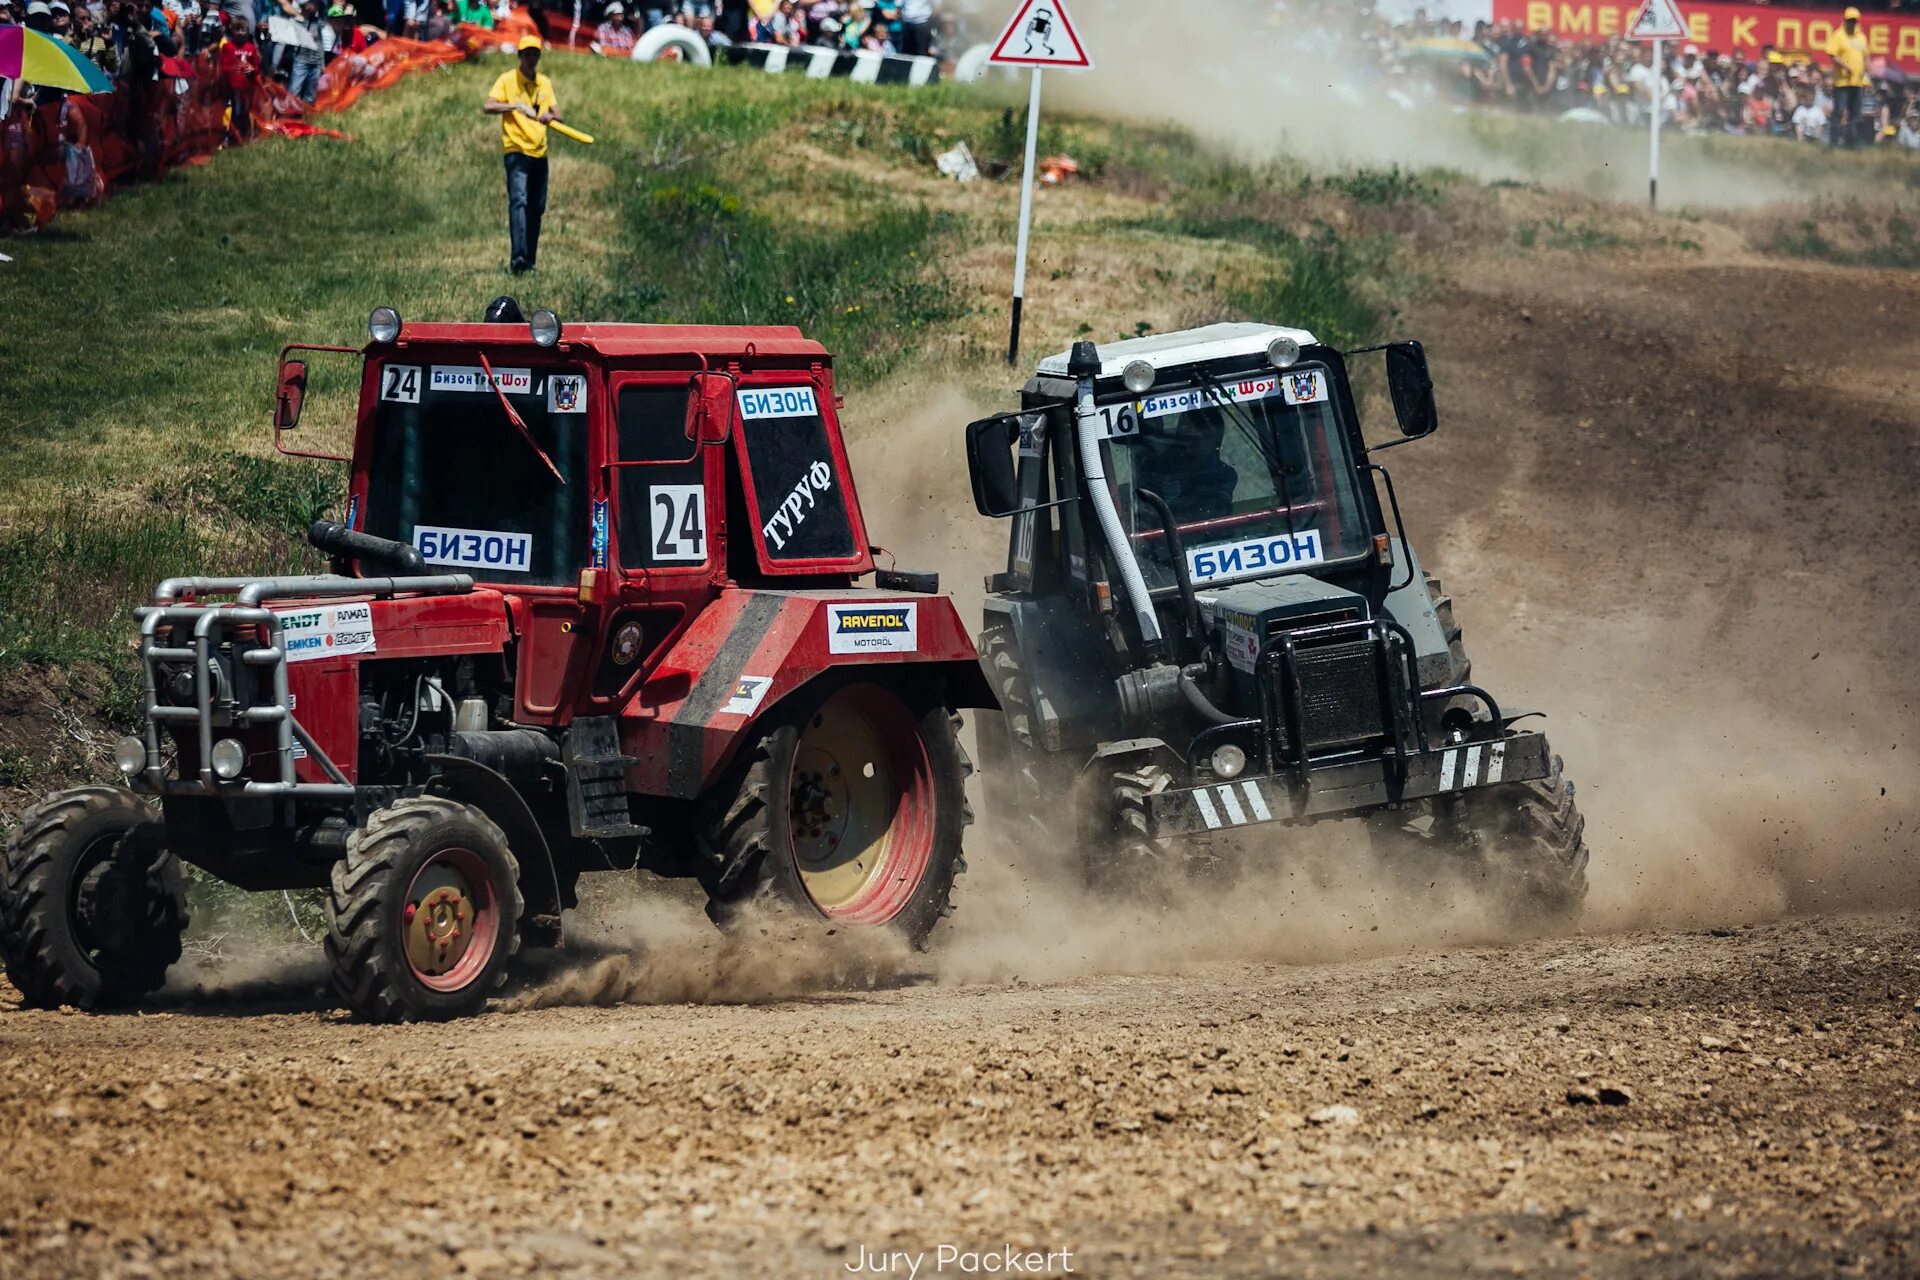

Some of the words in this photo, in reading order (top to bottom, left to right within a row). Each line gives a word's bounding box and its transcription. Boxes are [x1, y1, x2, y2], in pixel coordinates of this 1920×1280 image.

[1526, 0, 1711, 43] ВМЕЕ
[1732, 15, 1759, 47] К
[1776, 17, 1920, 62] ПОЕД
[385, 366, 417, 400] 24
[742, 391, 813, 415] БИЗОН
[1099, 404, 1134, 436] 16
[762, 460, 832, 551] ТУРУФ
[655, 492, 704, 555] 24
[1019, 504, 1036, 560] 16
[418, 531, 527, 566] БИЗОН
[1194, 535, 1316, 577] БИЗОН
[280, 613, 322, 631] ENDT
[842, 614, 904, 629] RAVENOL
[285, 636, 321, 651] EMKEN
[854, 636, 893, 647] MOTORÖL
